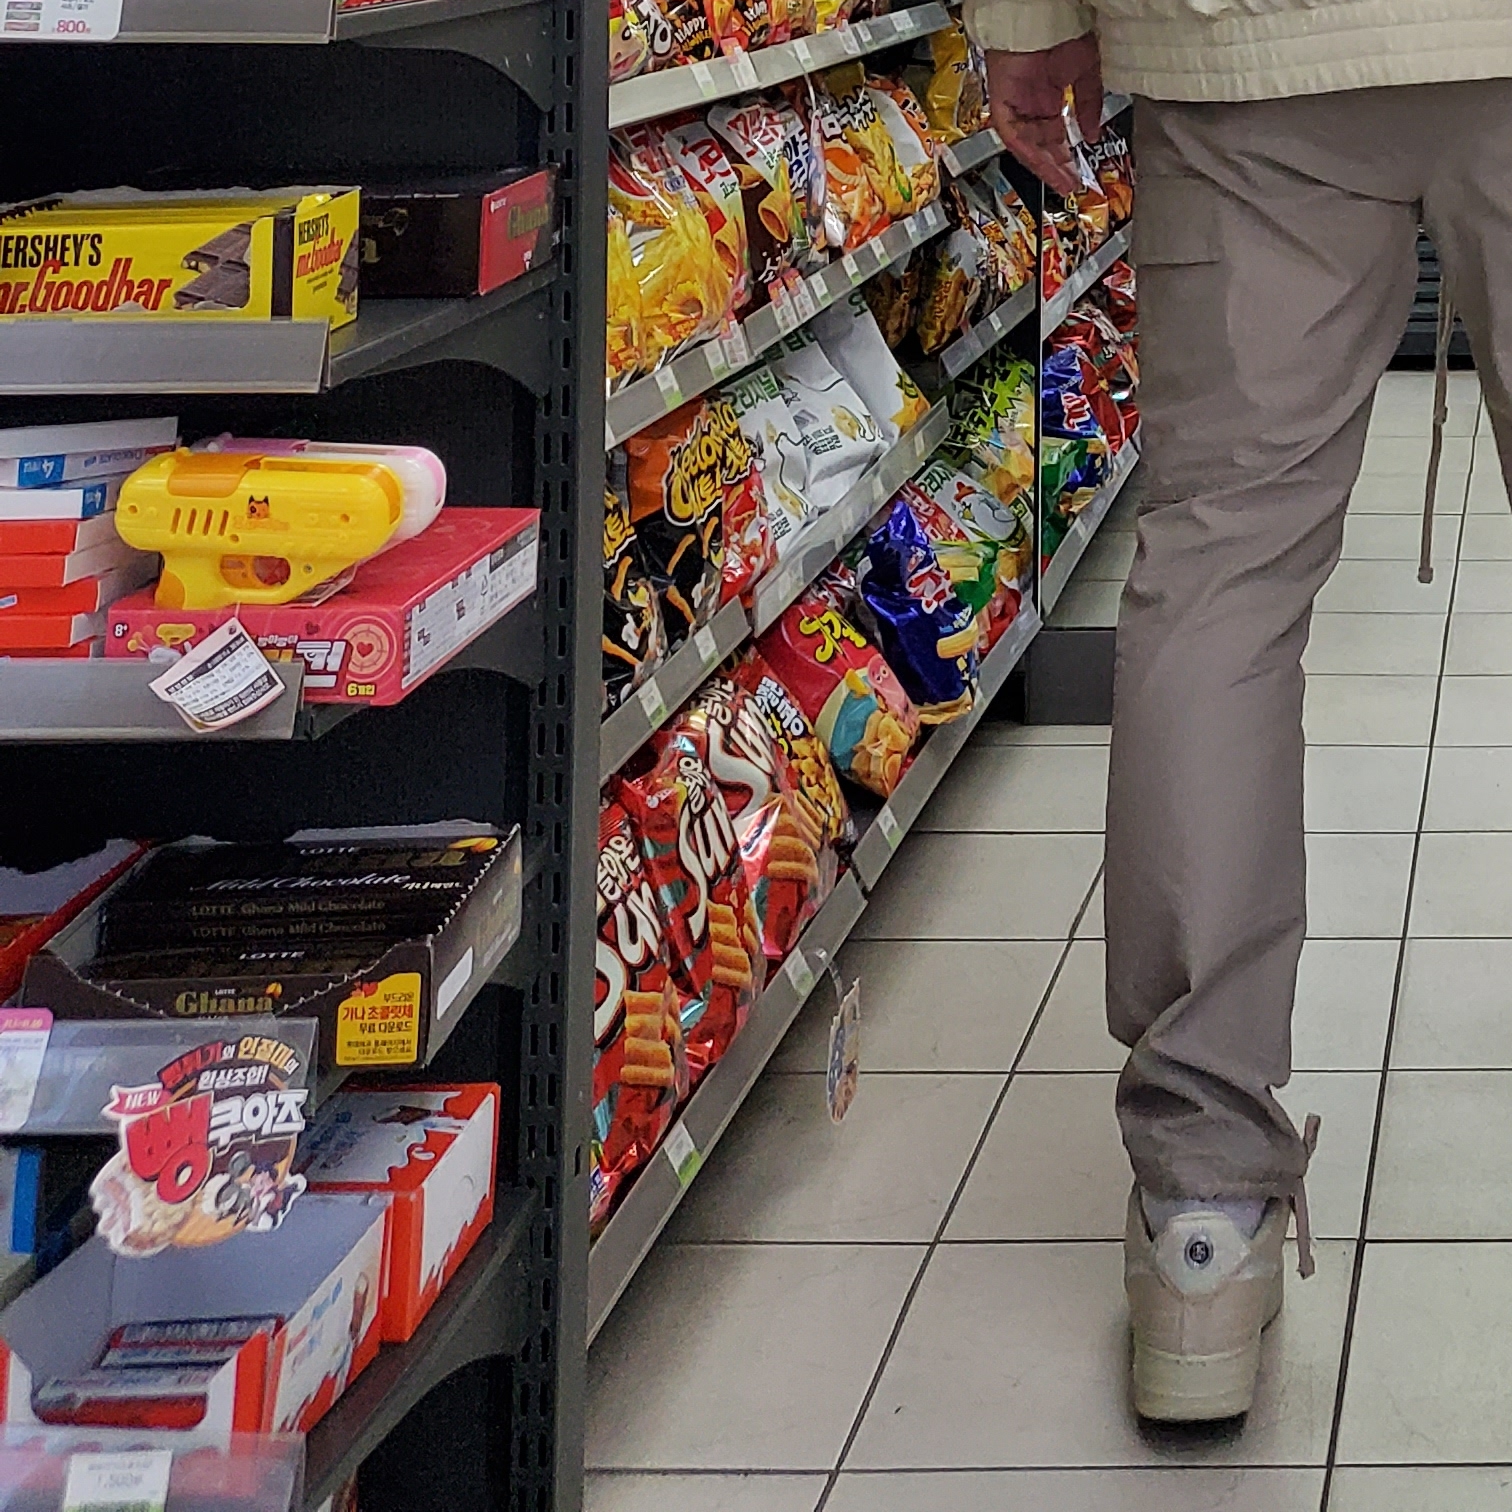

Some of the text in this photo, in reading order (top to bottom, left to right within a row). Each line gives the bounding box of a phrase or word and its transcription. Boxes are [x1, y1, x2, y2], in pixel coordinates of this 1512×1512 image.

[238, 950, 305, 961] LOTTE
[175, 990, 273, 1015] Ghana
[342, 1006, 366, 1021] 가나
[359, 1020, 412, 1034] 무료 다운로드
[124, 1089, 161, 1110] NEW
